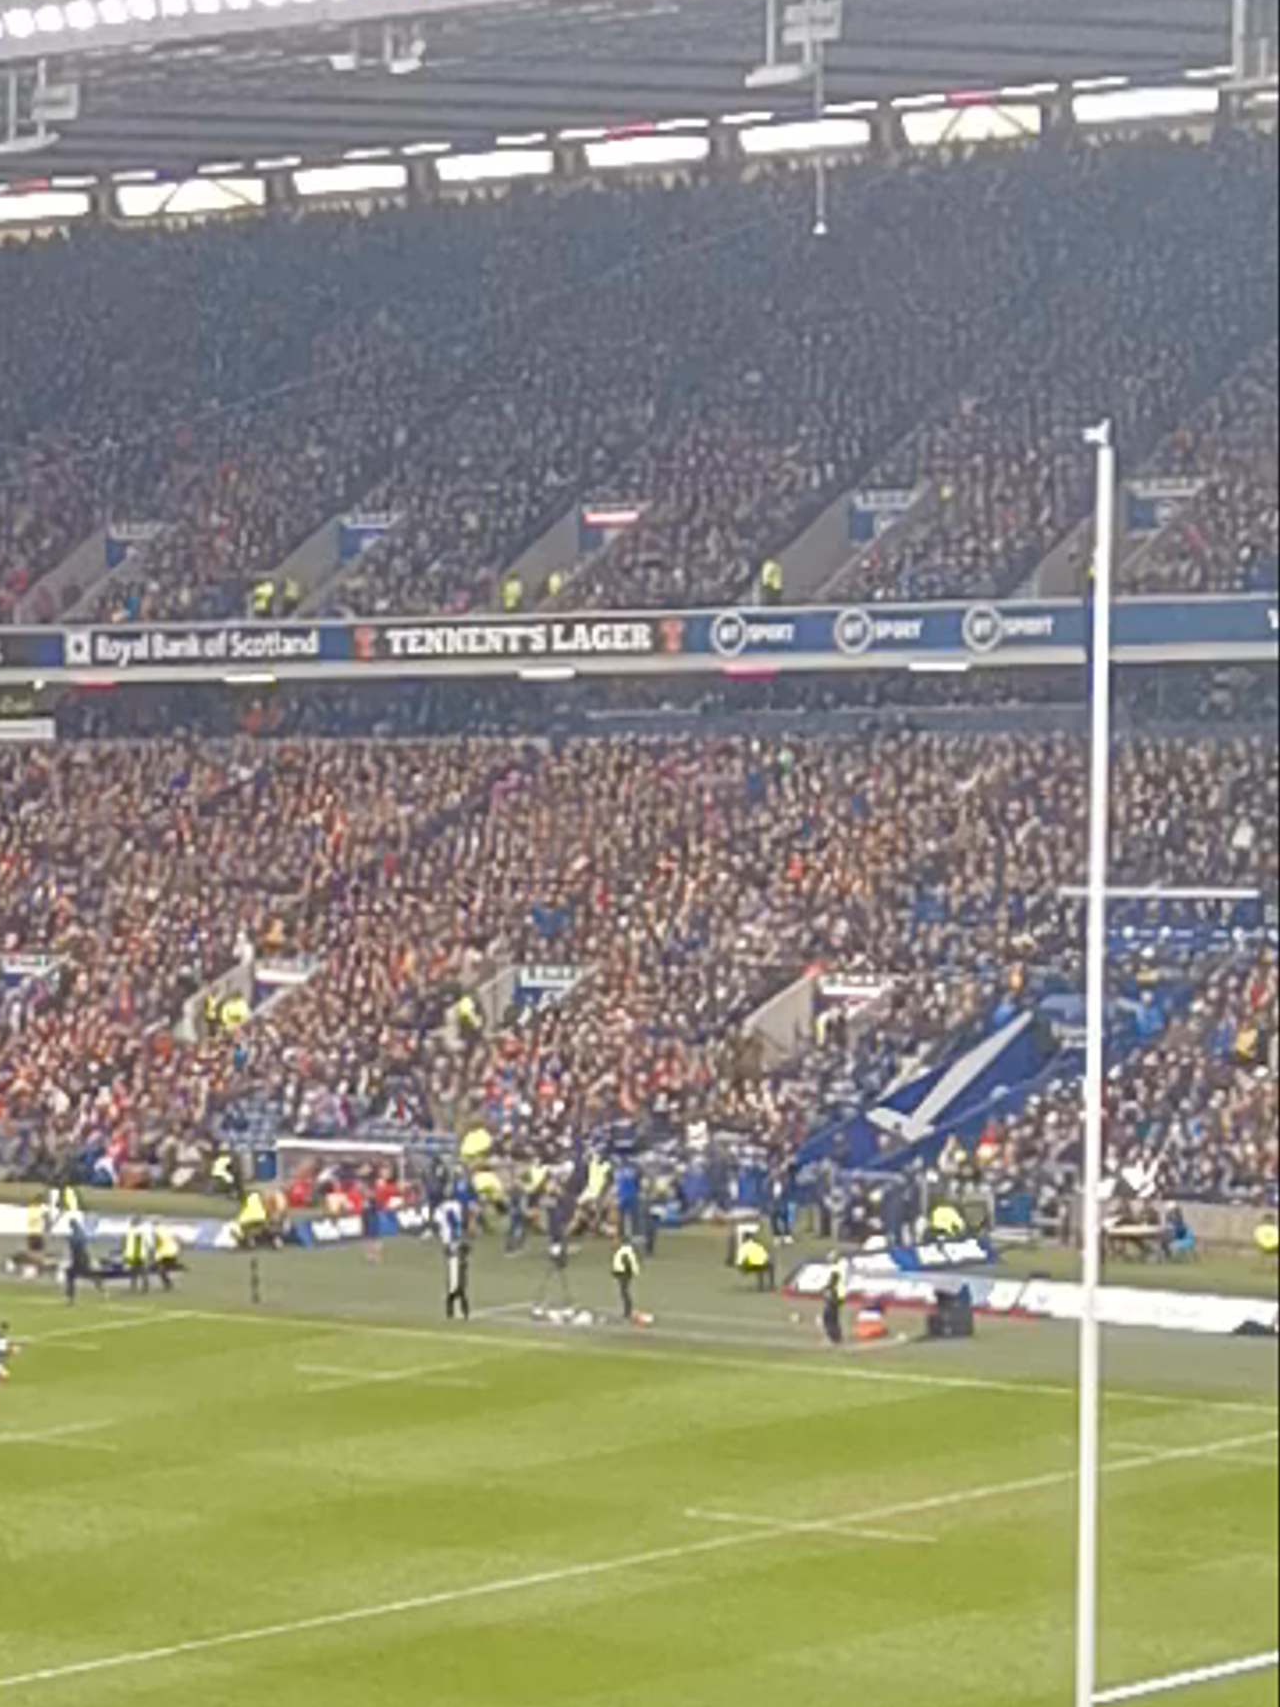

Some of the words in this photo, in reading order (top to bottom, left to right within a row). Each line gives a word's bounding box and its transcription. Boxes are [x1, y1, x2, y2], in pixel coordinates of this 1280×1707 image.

[746, 623, 794, 641] SPORT
[875, 619, 923, 640] SPORT
[1002, 615, 1054, 636] SPORT
[95, 633, 149, 667] Royal
[152, 631, 200, 659] Bank
[204, 629, 227, 657] of
[230, 627, 319, 657] Scotland
[386, 625, 547, 655] TENNENT'S
[552, 623, 653, 651] LAGER
